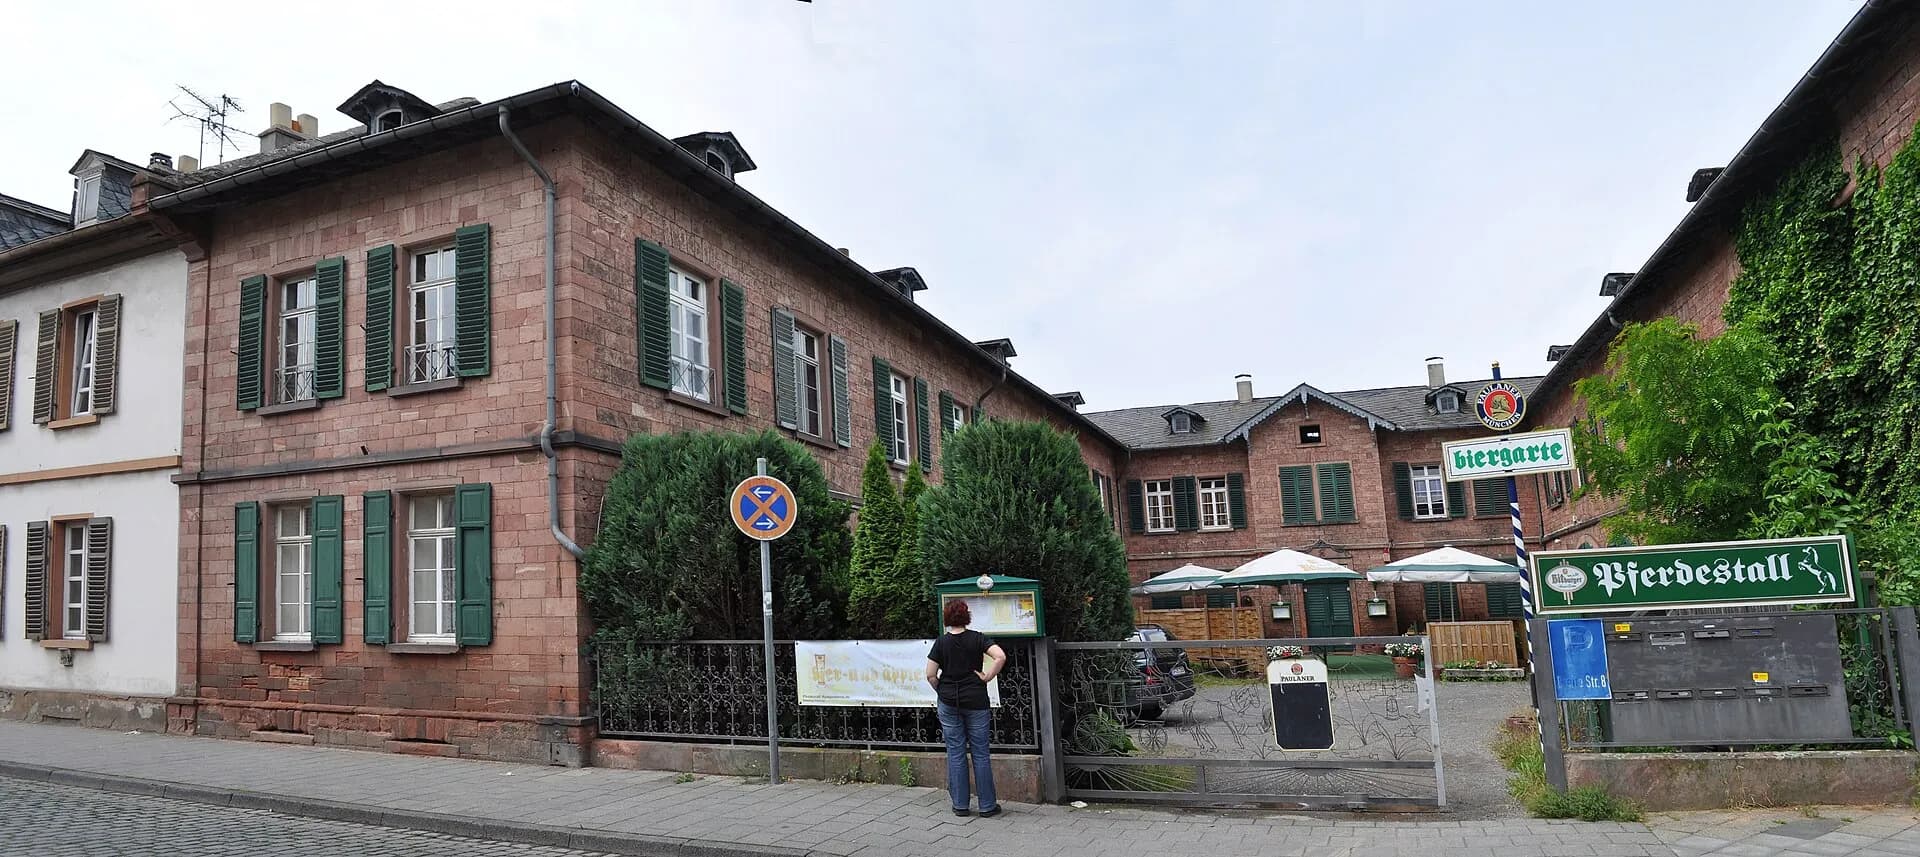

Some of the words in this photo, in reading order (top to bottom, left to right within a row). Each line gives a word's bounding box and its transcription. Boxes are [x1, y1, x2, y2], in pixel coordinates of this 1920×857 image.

[1477, 383, 1521, 404] PAULANER
[1483, 412, 1521, 428] MÜNCHEN
[1453, 442, 1563, 470] biergarte
[1551, 574, 1582, 585] Bitburger
[1592, 552, 1794, 598] Pferdestall
[1585, 674, 1600, 689] Str.
[1600, 674, 1607, 688] 8
